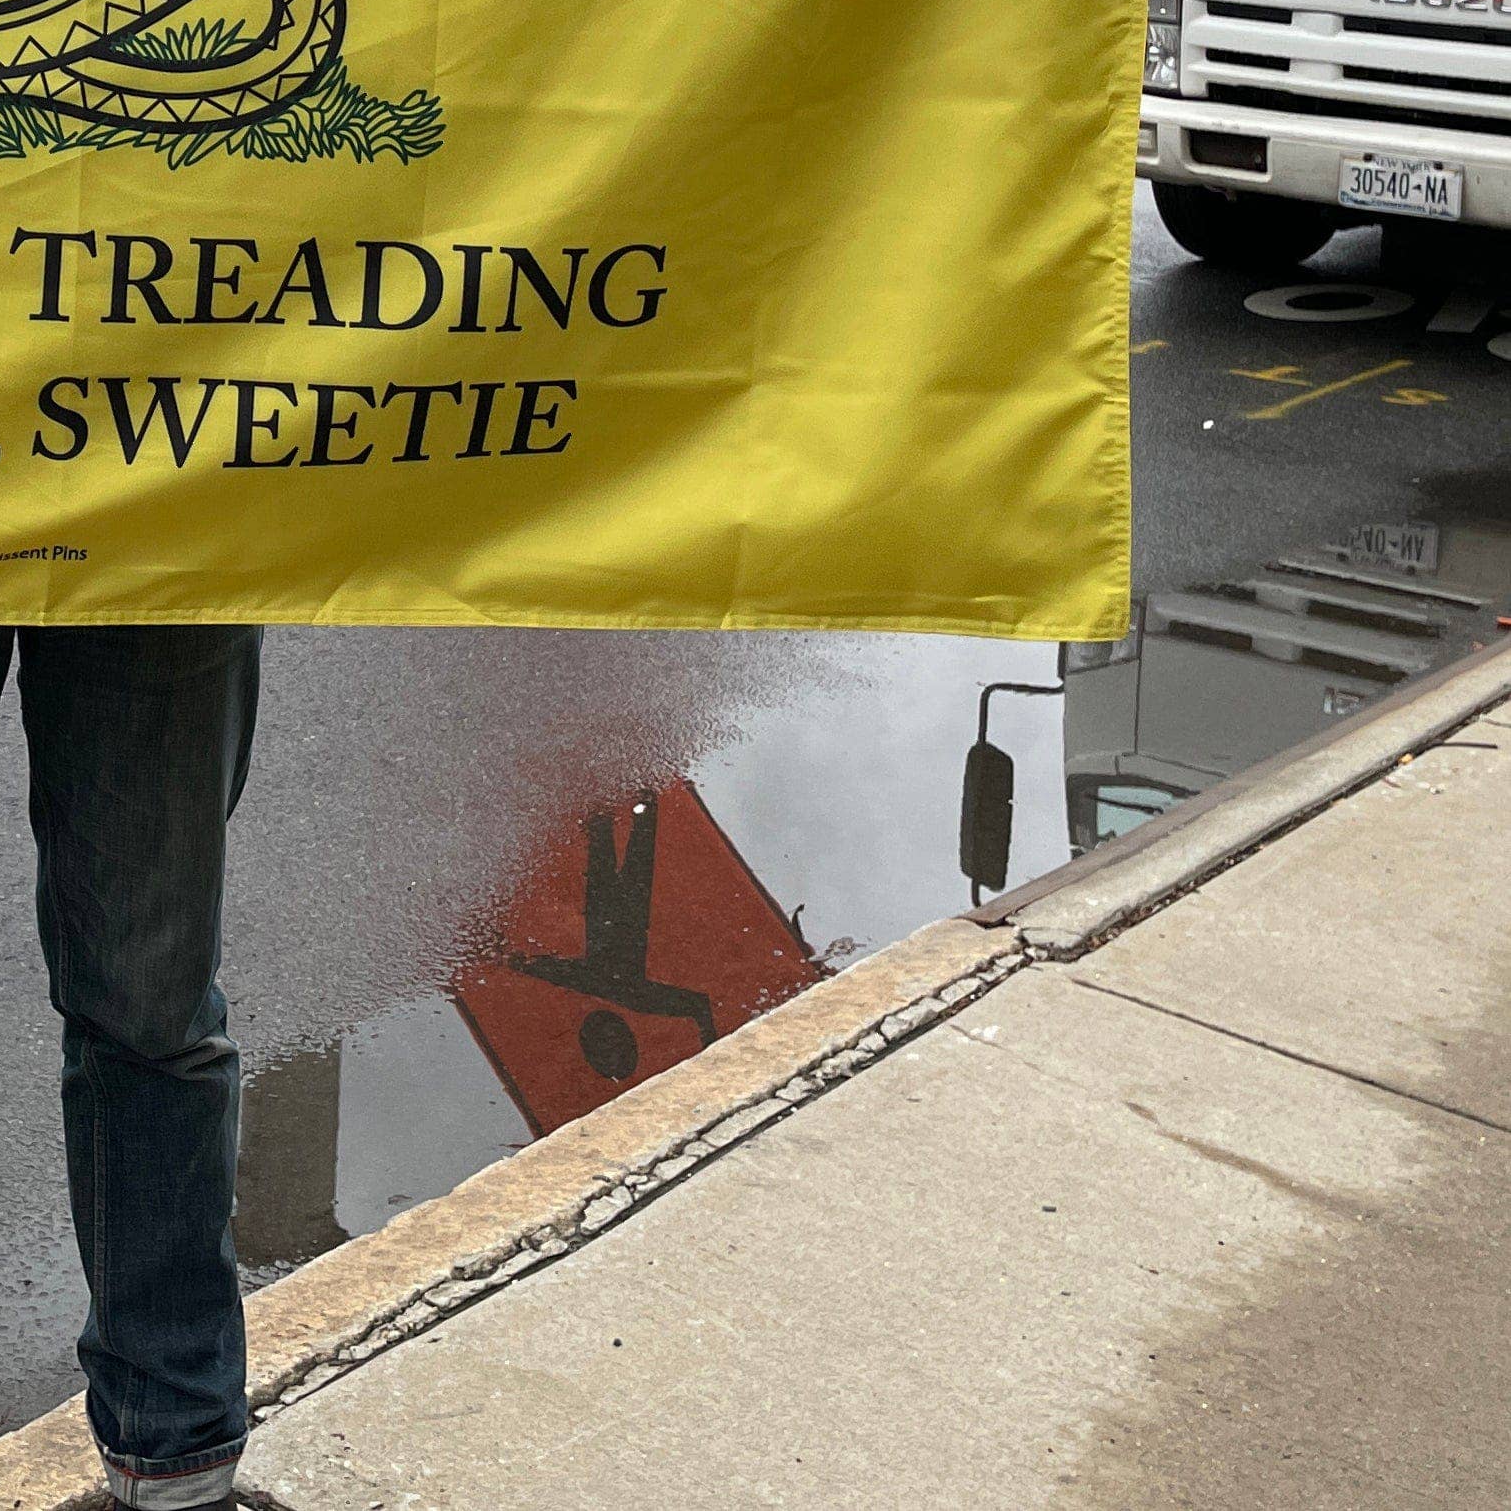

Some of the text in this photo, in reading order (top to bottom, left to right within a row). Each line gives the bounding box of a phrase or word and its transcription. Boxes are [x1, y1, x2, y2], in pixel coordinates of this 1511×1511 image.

[9, 227, 668, 334] TREADING
[31, 376, 578, 469] SWEETIE
[51, 545, 88, 562] Pins
